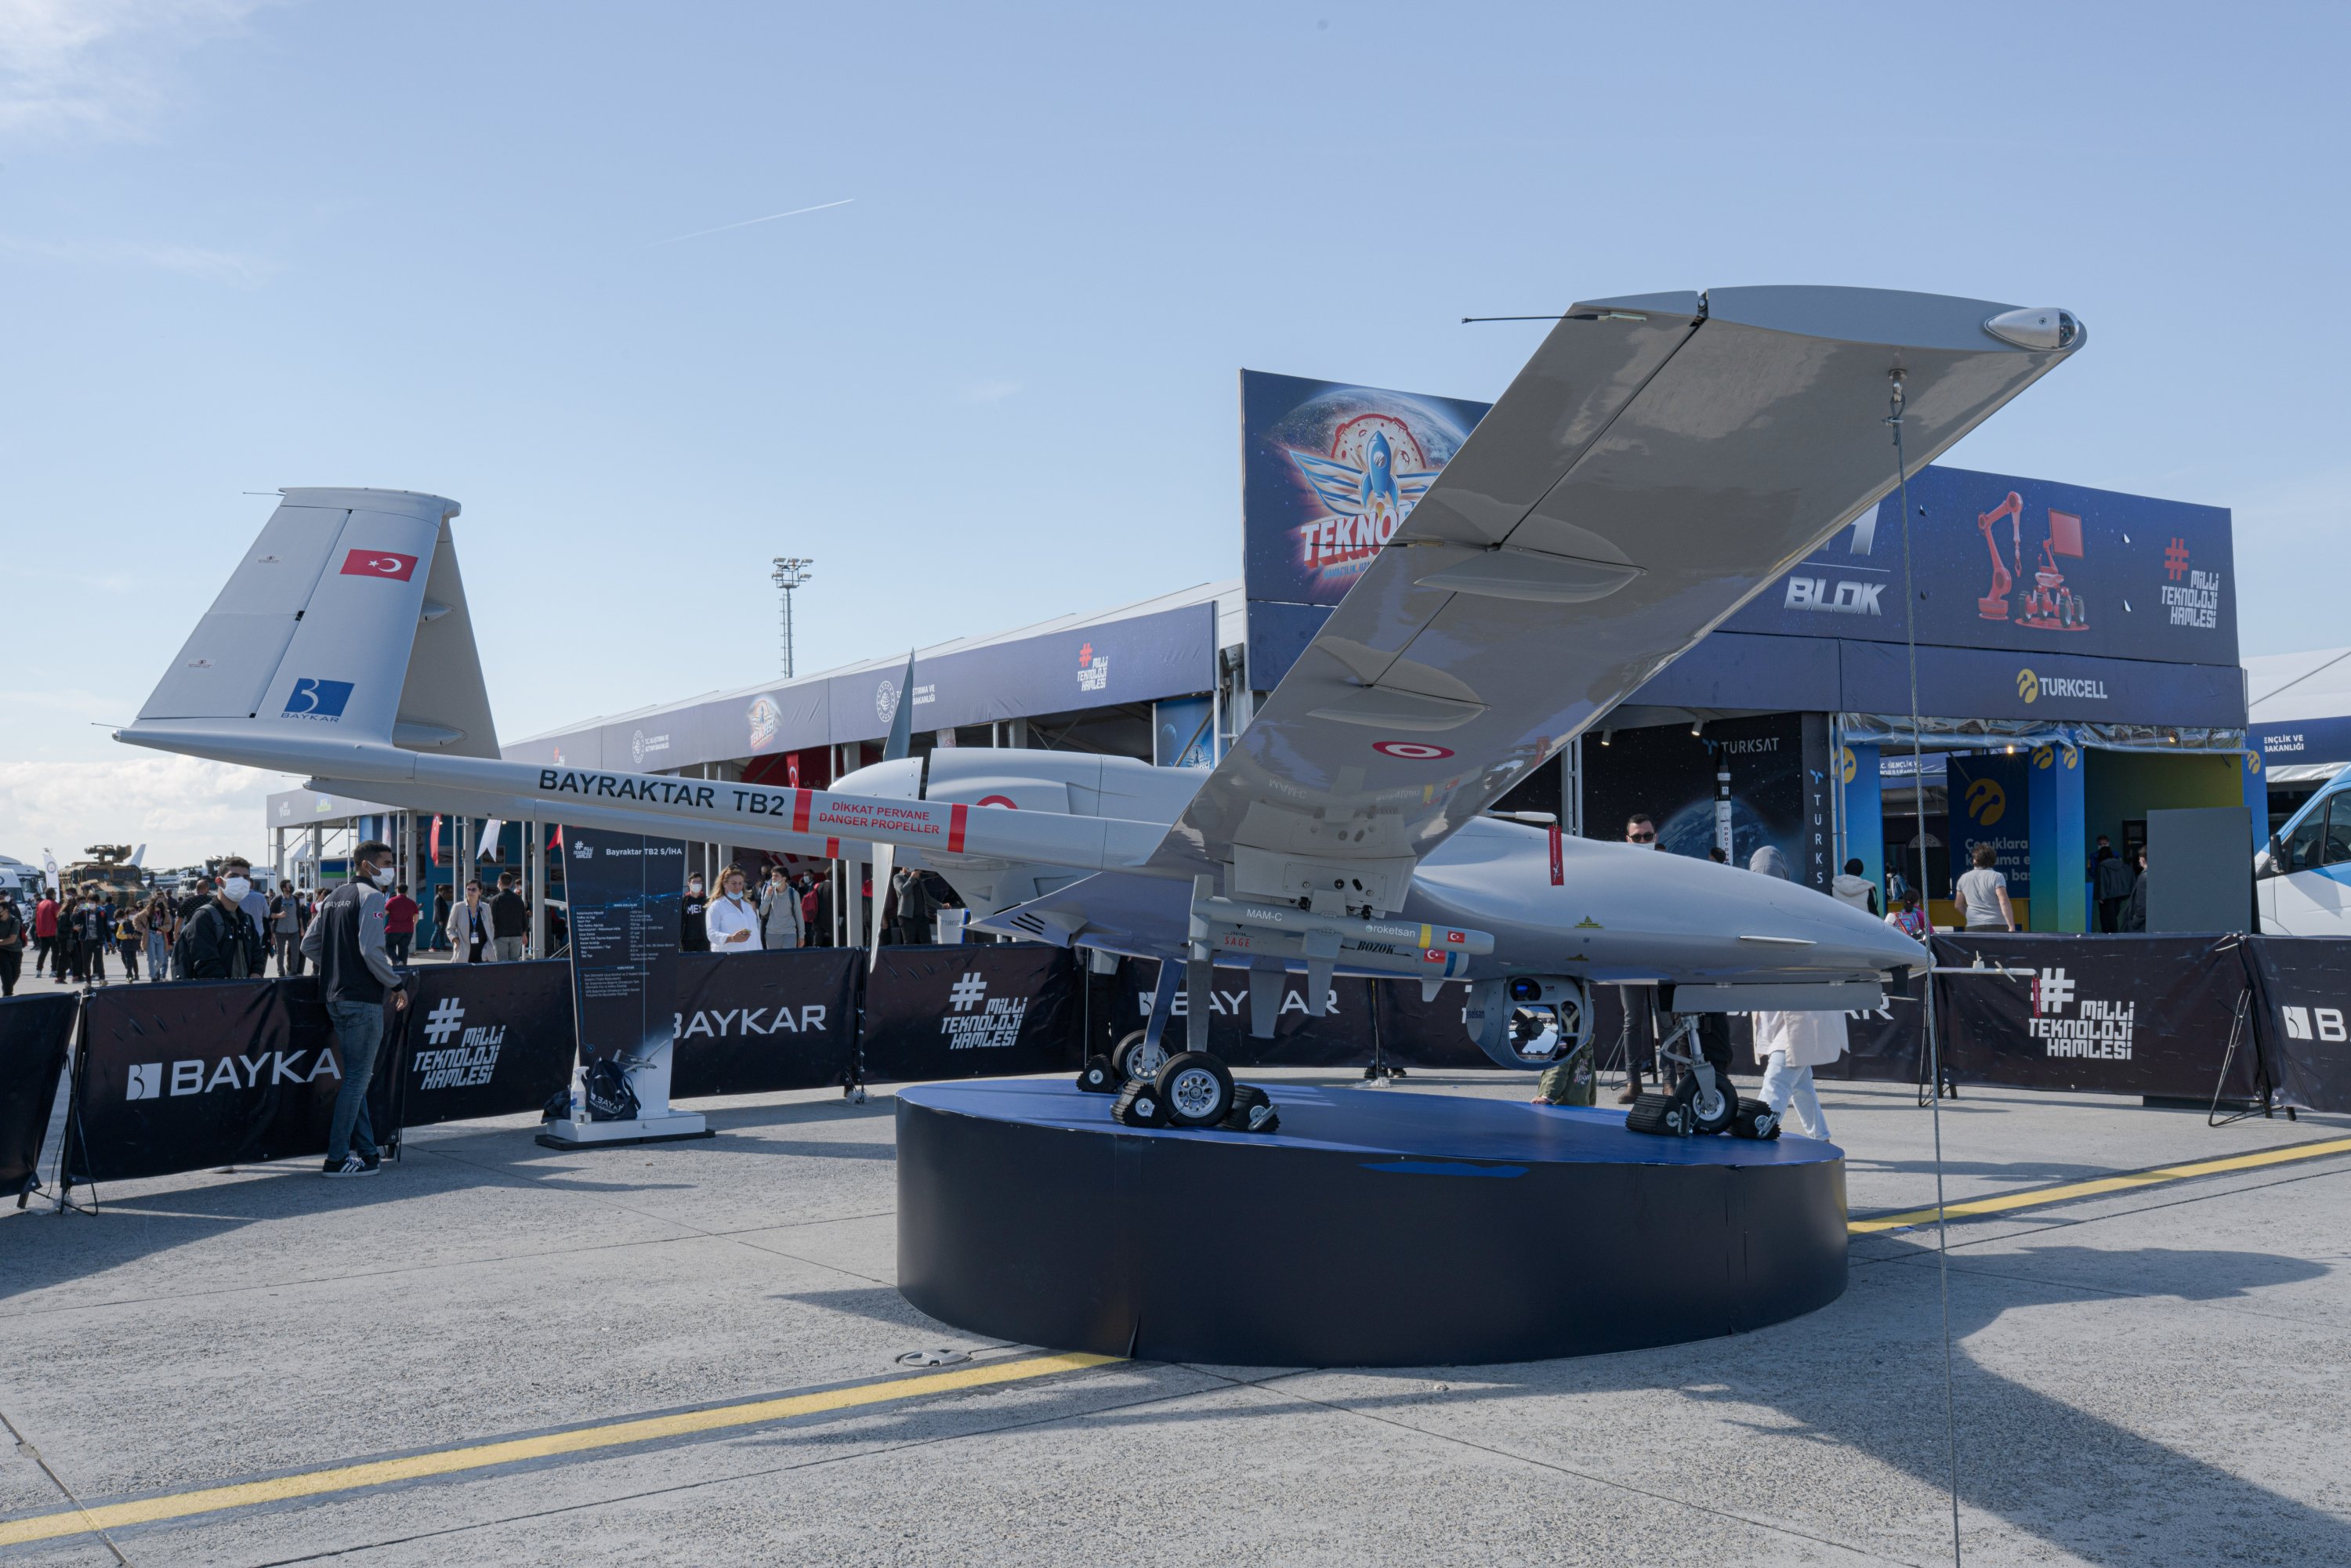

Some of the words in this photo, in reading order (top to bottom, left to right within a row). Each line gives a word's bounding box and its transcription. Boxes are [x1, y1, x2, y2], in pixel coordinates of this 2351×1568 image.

[1784, 576, 1886, 616] BLOK
[2161, 585, 2218, 610] TEKNOLOJİ
[2170, 606, 2216, 628] HAMLESİ
[2040, 677, 2107, 699] TURKCELL
[281, 712, 339, 722] BAYKAR
[2264, 743, 2304, 752] BAKANLIĞI
[539, 770, 715, 809] BAYRAKTAR
[733, 790, 785, 817] TB2
[832, 802, 874, 815] DİKKAT
[877, 807, 930, 820] PERVANE
[819, 813, 868, 827] DANGER
[871, 820, 940, 835] PROPELLER
[606, 848, 642, 856] Bayraktar
[660, 846, 682, 856] S/İHA
[1247, 909, 1282, 922] MAM-C
[1374, 923, 1415, 937] roketsan
[1224, 936, 1250, 947] SAGE
[1357, 940, 1396, 955] BOZOK
[941, 1014, 1023, 1034] TEKNOLOJİ
[2029, 1018, 2132, 1041] TEKNOLOJİ
[2314, 1008, 2351, 1042] B
[950, 1030, 1019, 1049] HAMLESİ
[2047, 1038, 2132, 1060] HAMLESİ
[413, 1045, 501, 1072] TEKNOLOJİ
[170, 1048, 342, 1096] BAYKA
[420, 1065, 494, 1090] HAMLESİ
